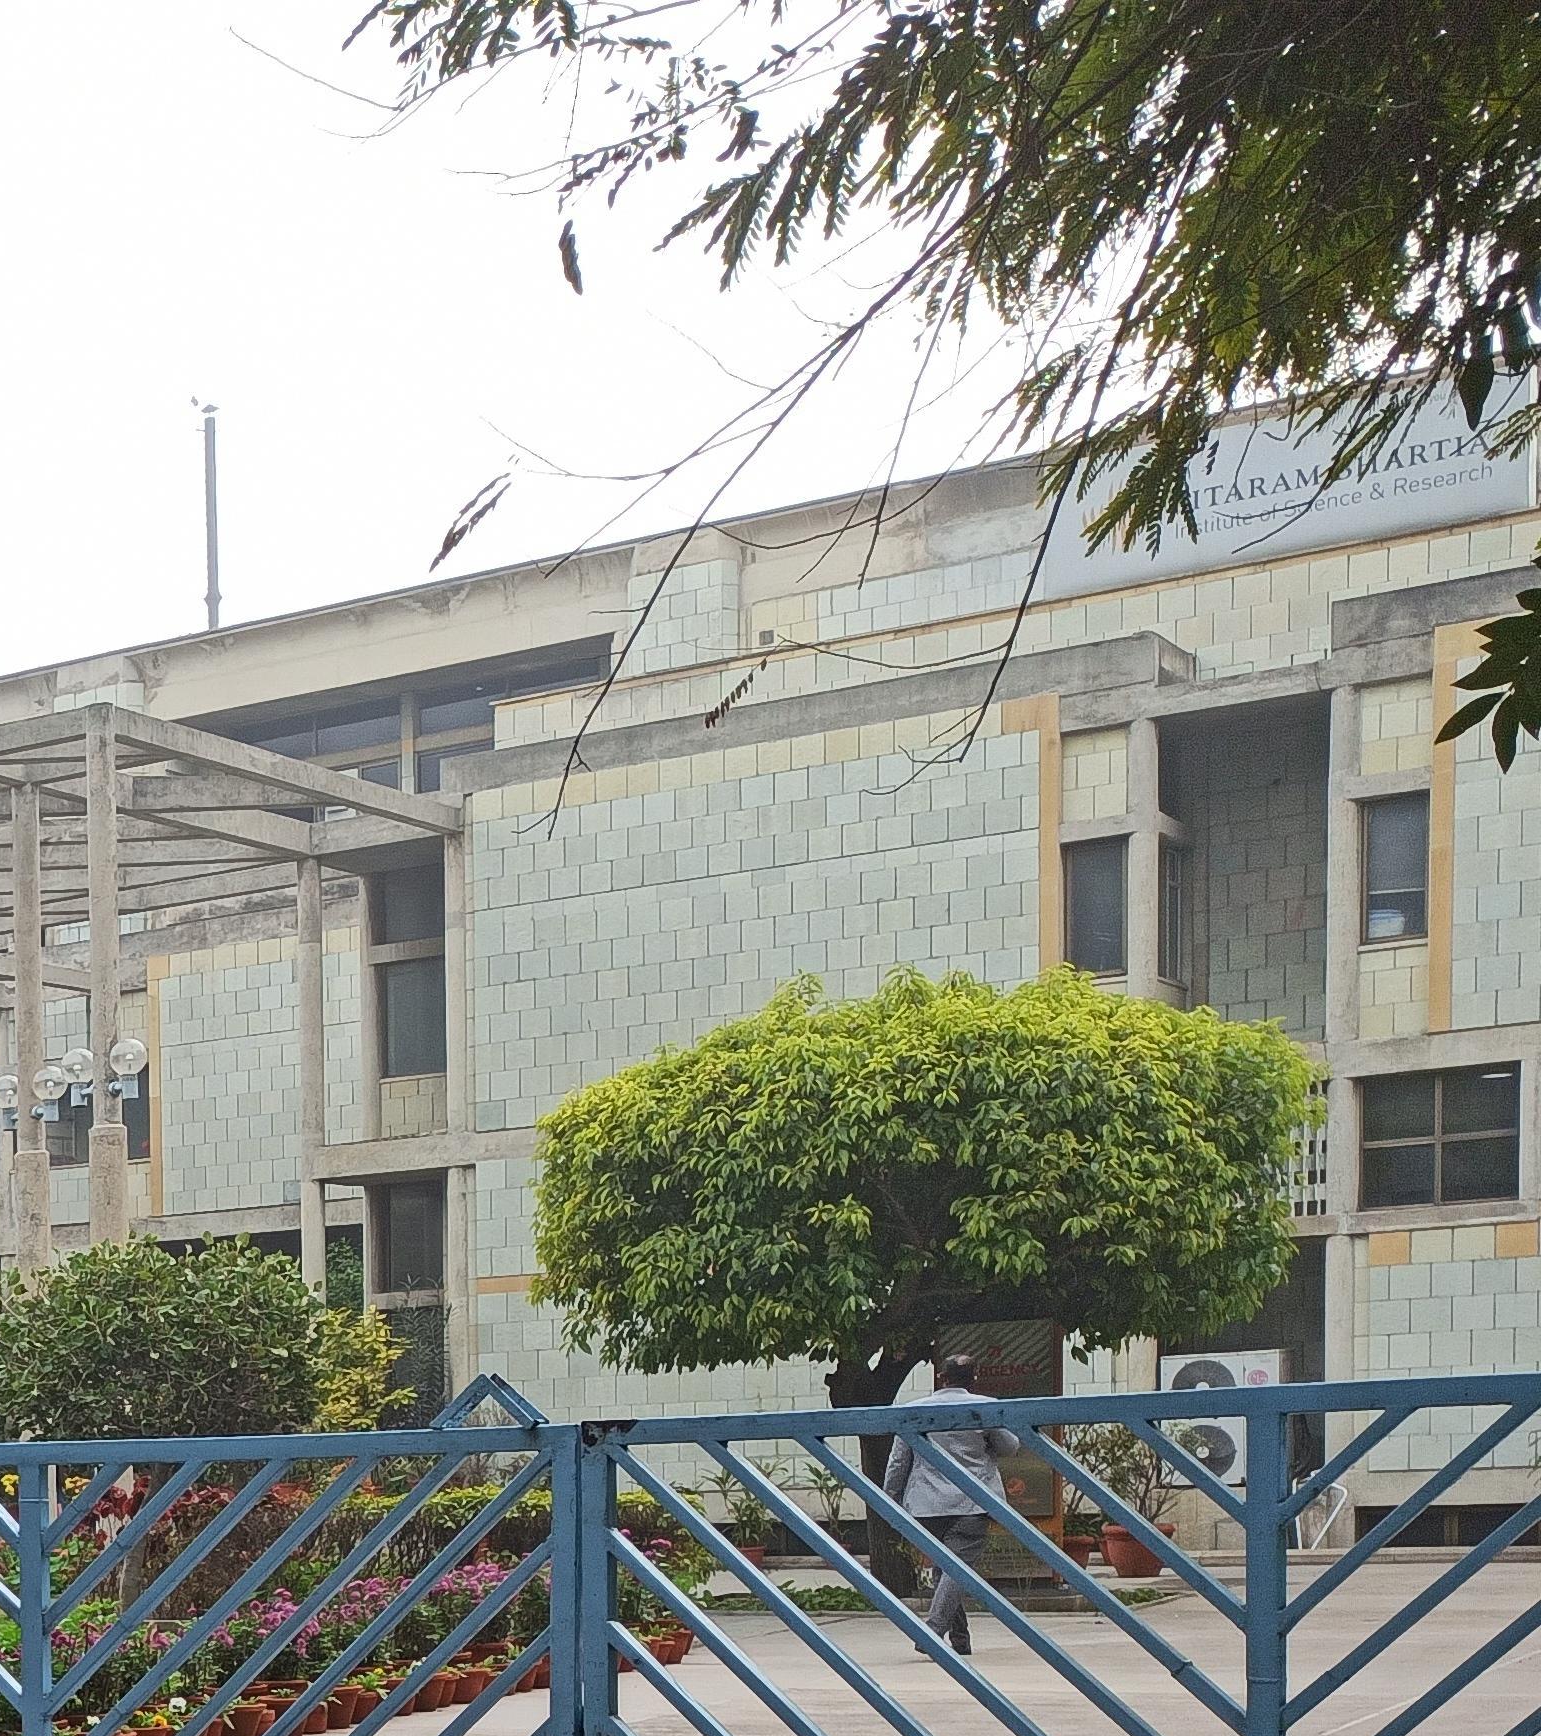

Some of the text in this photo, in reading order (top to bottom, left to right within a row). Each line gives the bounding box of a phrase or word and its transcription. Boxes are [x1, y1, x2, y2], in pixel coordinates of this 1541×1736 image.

[1192, 464, 1321, 510] ITARAM
[1285, 490, 1363, 518] Scence
[1370, 482, 1385, 501] &
[1393, 461, 1493, 496] Research
